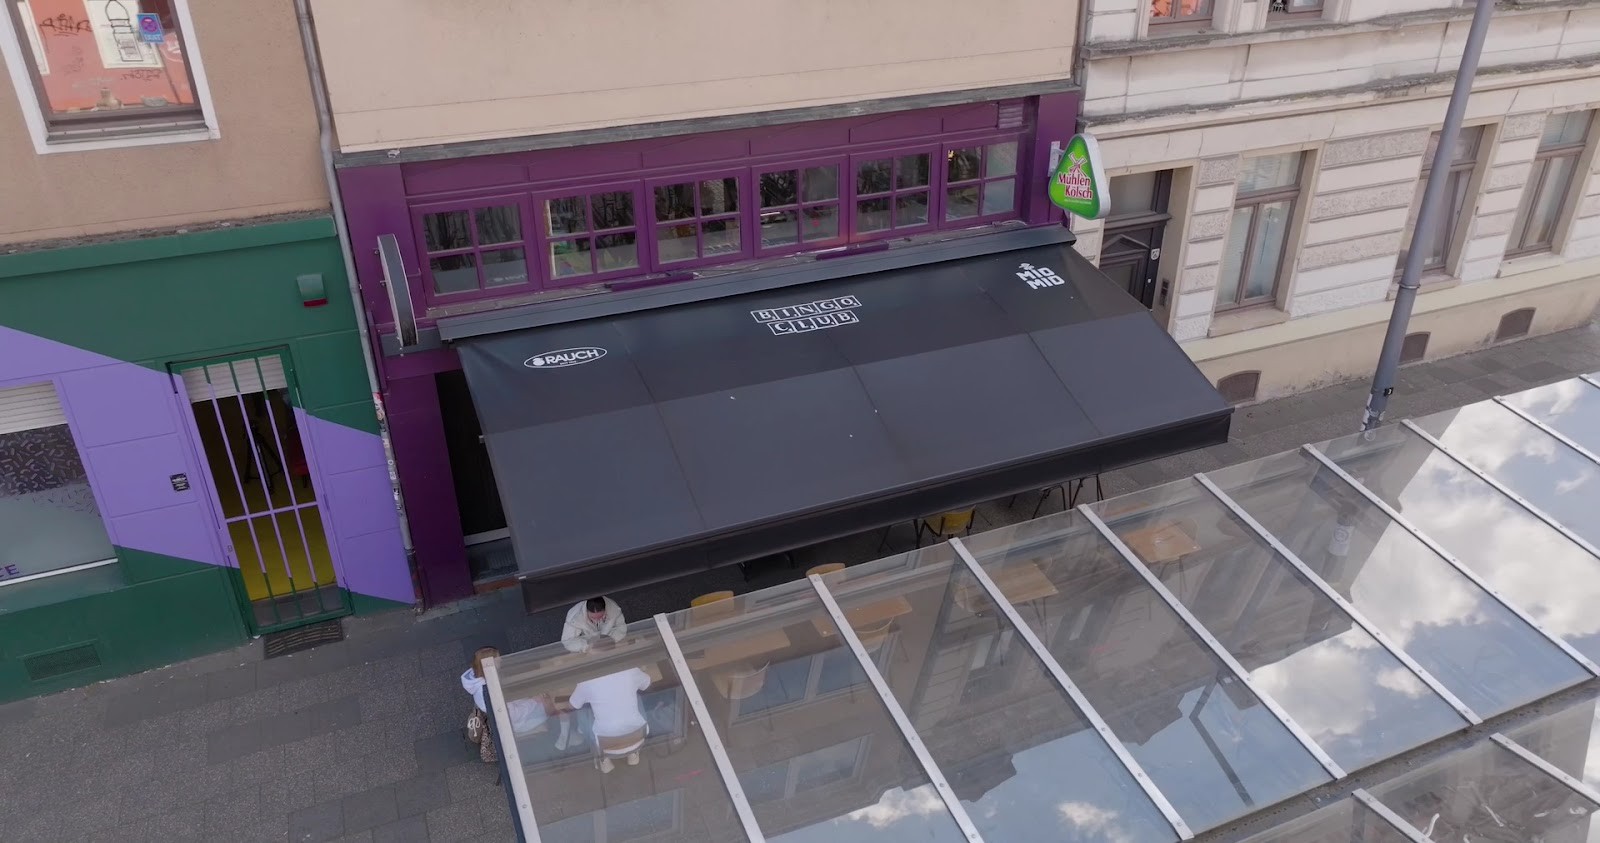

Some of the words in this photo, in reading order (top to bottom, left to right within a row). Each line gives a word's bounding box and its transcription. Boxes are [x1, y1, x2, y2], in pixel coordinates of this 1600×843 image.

[1058, 173, 1091, 186] Mühlen
[1065, 185, 1093, 199] Kölsch
[1016, 267, 1055, 281] MID
[1026, 275, 1065, 290] MID
[758, 297, 858, 320] BINGO
[773, 312, 856, 333] CLUB
[544, 349, 600, 365] RAUCH
